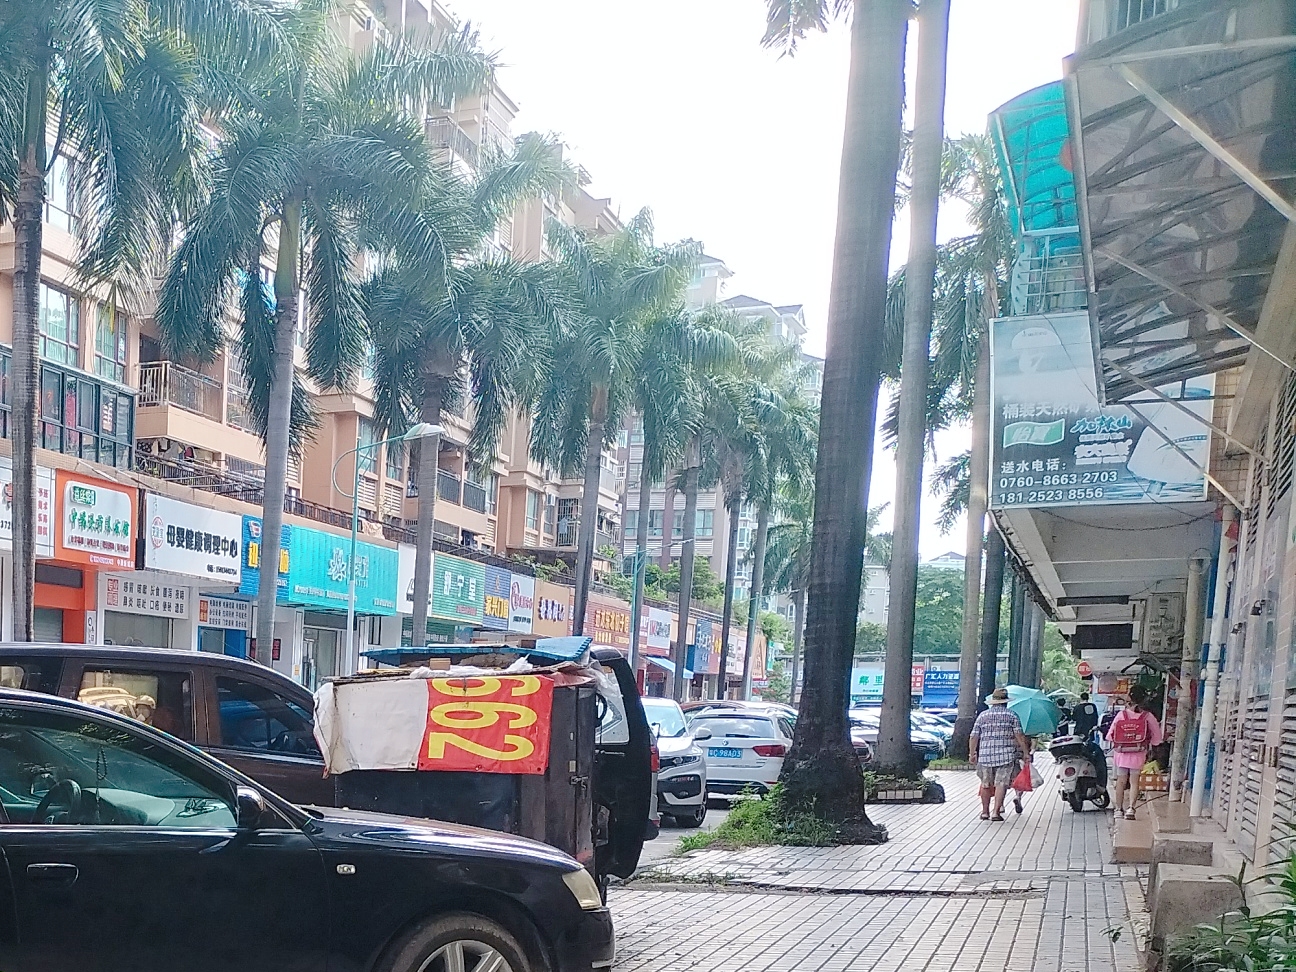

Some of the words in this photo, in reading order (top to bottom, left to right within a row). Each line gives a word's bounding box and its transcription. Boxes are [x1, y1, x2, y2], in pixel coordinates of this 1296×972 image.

[999, 474, 1077, 488] 0760-8663
[1082, 472, 1117, 484] 2703
[999, 492, 1023, 504] 181
[1029, 490, 1065, 502] 2523
[1068, 488, 1103, 499] 8556
[166, 524, 238, 559] 母婴健康调理中心
